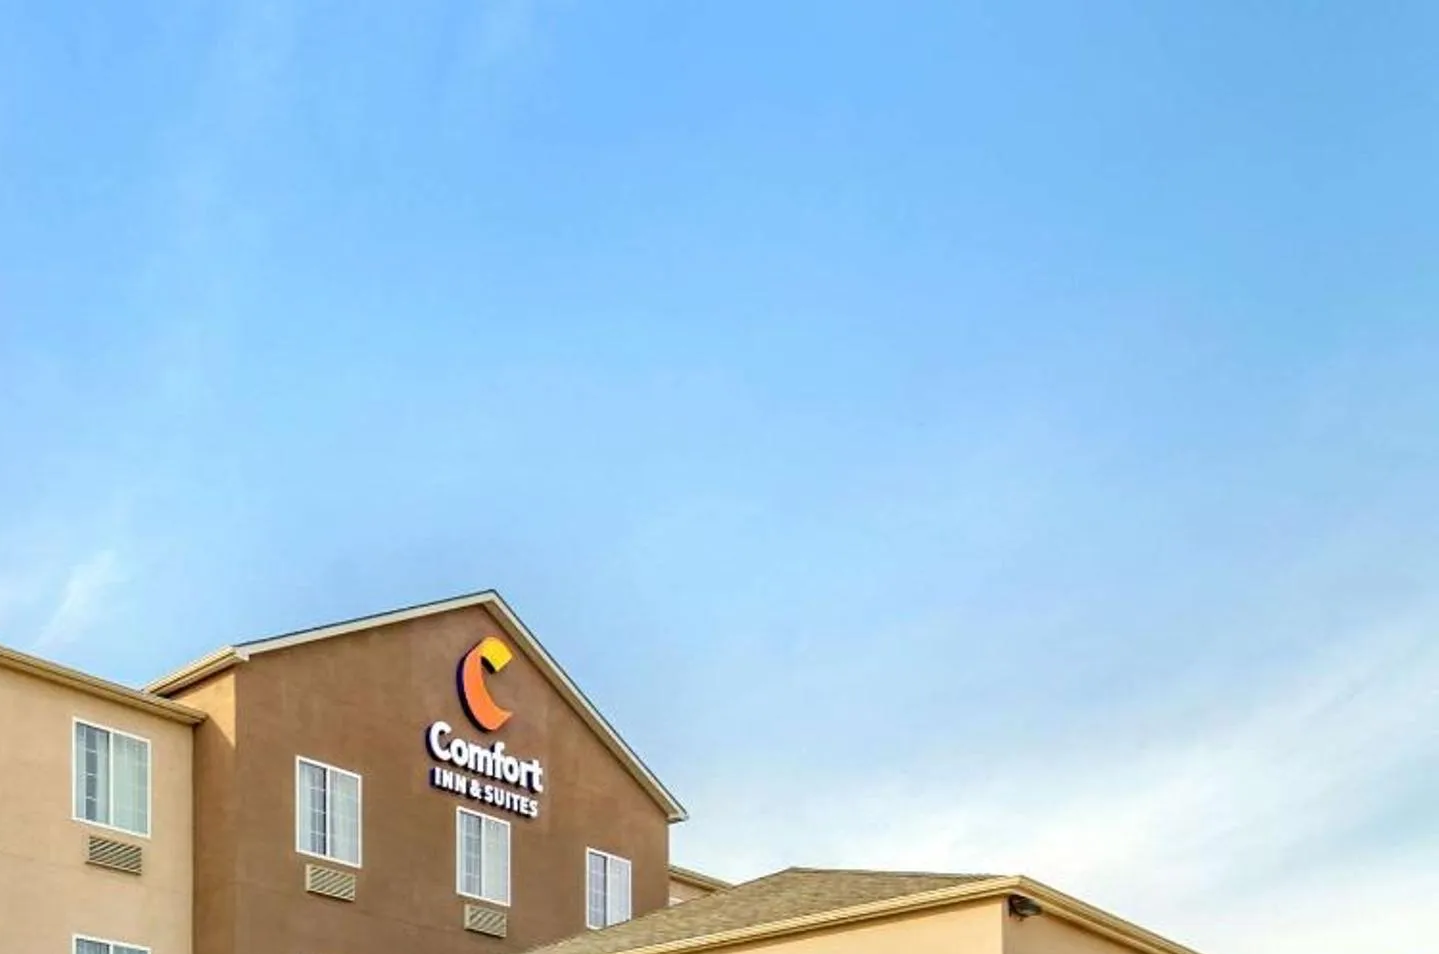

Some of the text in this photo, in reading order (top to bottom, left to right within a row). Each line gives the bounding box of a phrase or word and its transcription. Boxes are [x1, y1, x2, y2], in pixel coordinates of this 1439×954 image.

[428, 720, 543, 793] Comfort
[434, 766, 539, 817] INN & SUITES
